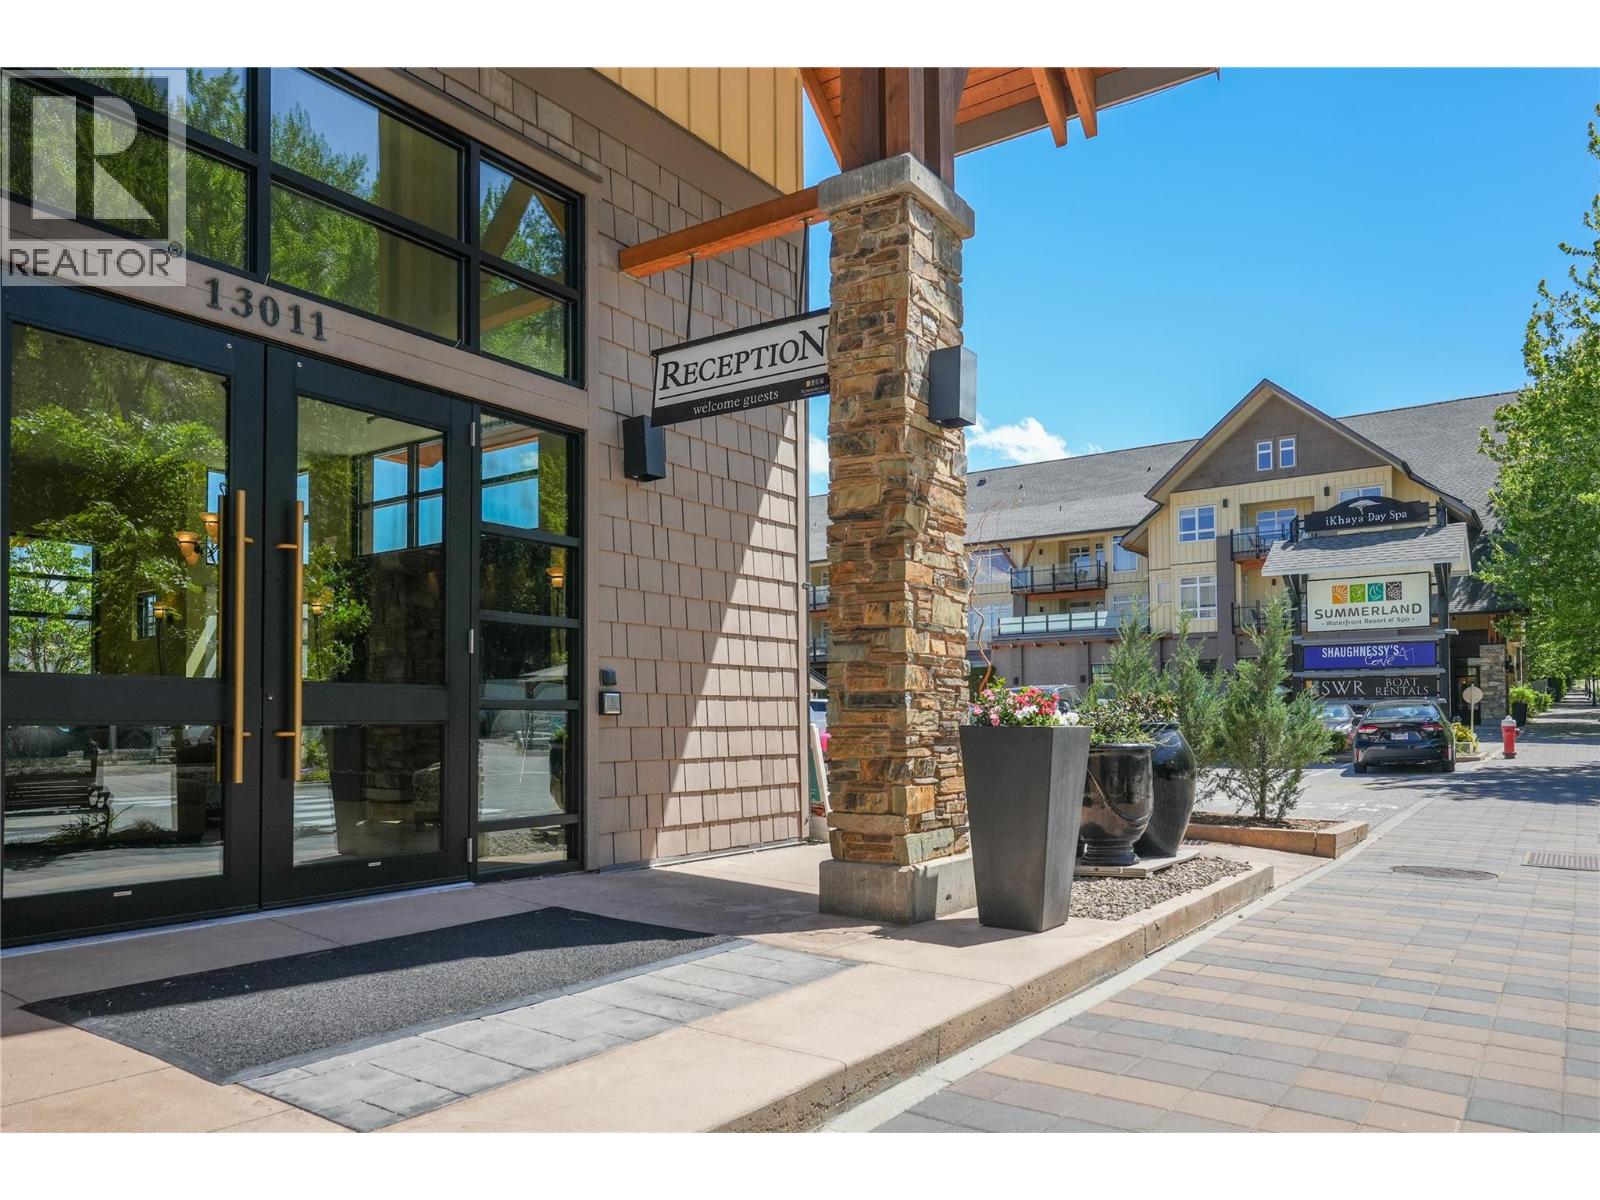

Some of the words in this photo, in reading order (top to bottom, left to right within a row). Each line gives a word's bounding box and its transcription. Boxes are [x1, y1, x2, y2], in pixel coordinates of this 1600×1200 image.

[204, 278, 327, 341] 13011
[659, 324, 828, 391] RECEPTION
[693, 398, 740, 415] welcome
[743, 389, 779, 408] guests
[1325, 515, 1364, 527] iKhaya
[1368, 512, 1387, 522] Day
[1389, 510, 1407, 520] Spa
[1314, 603, 1422, 620] SUMMERLAND
[1326, 619, 1362, 627] Waterfront
[1322, 644, 1399, 658] SHAUGHNESSY'S
[1364, 654, 1395, 666] Cove
[1321, 680, 1366, 696] SWR
[1385, 677, 1419, 686] BOAT
[1375, 686, 1430, 696] RENTALS
